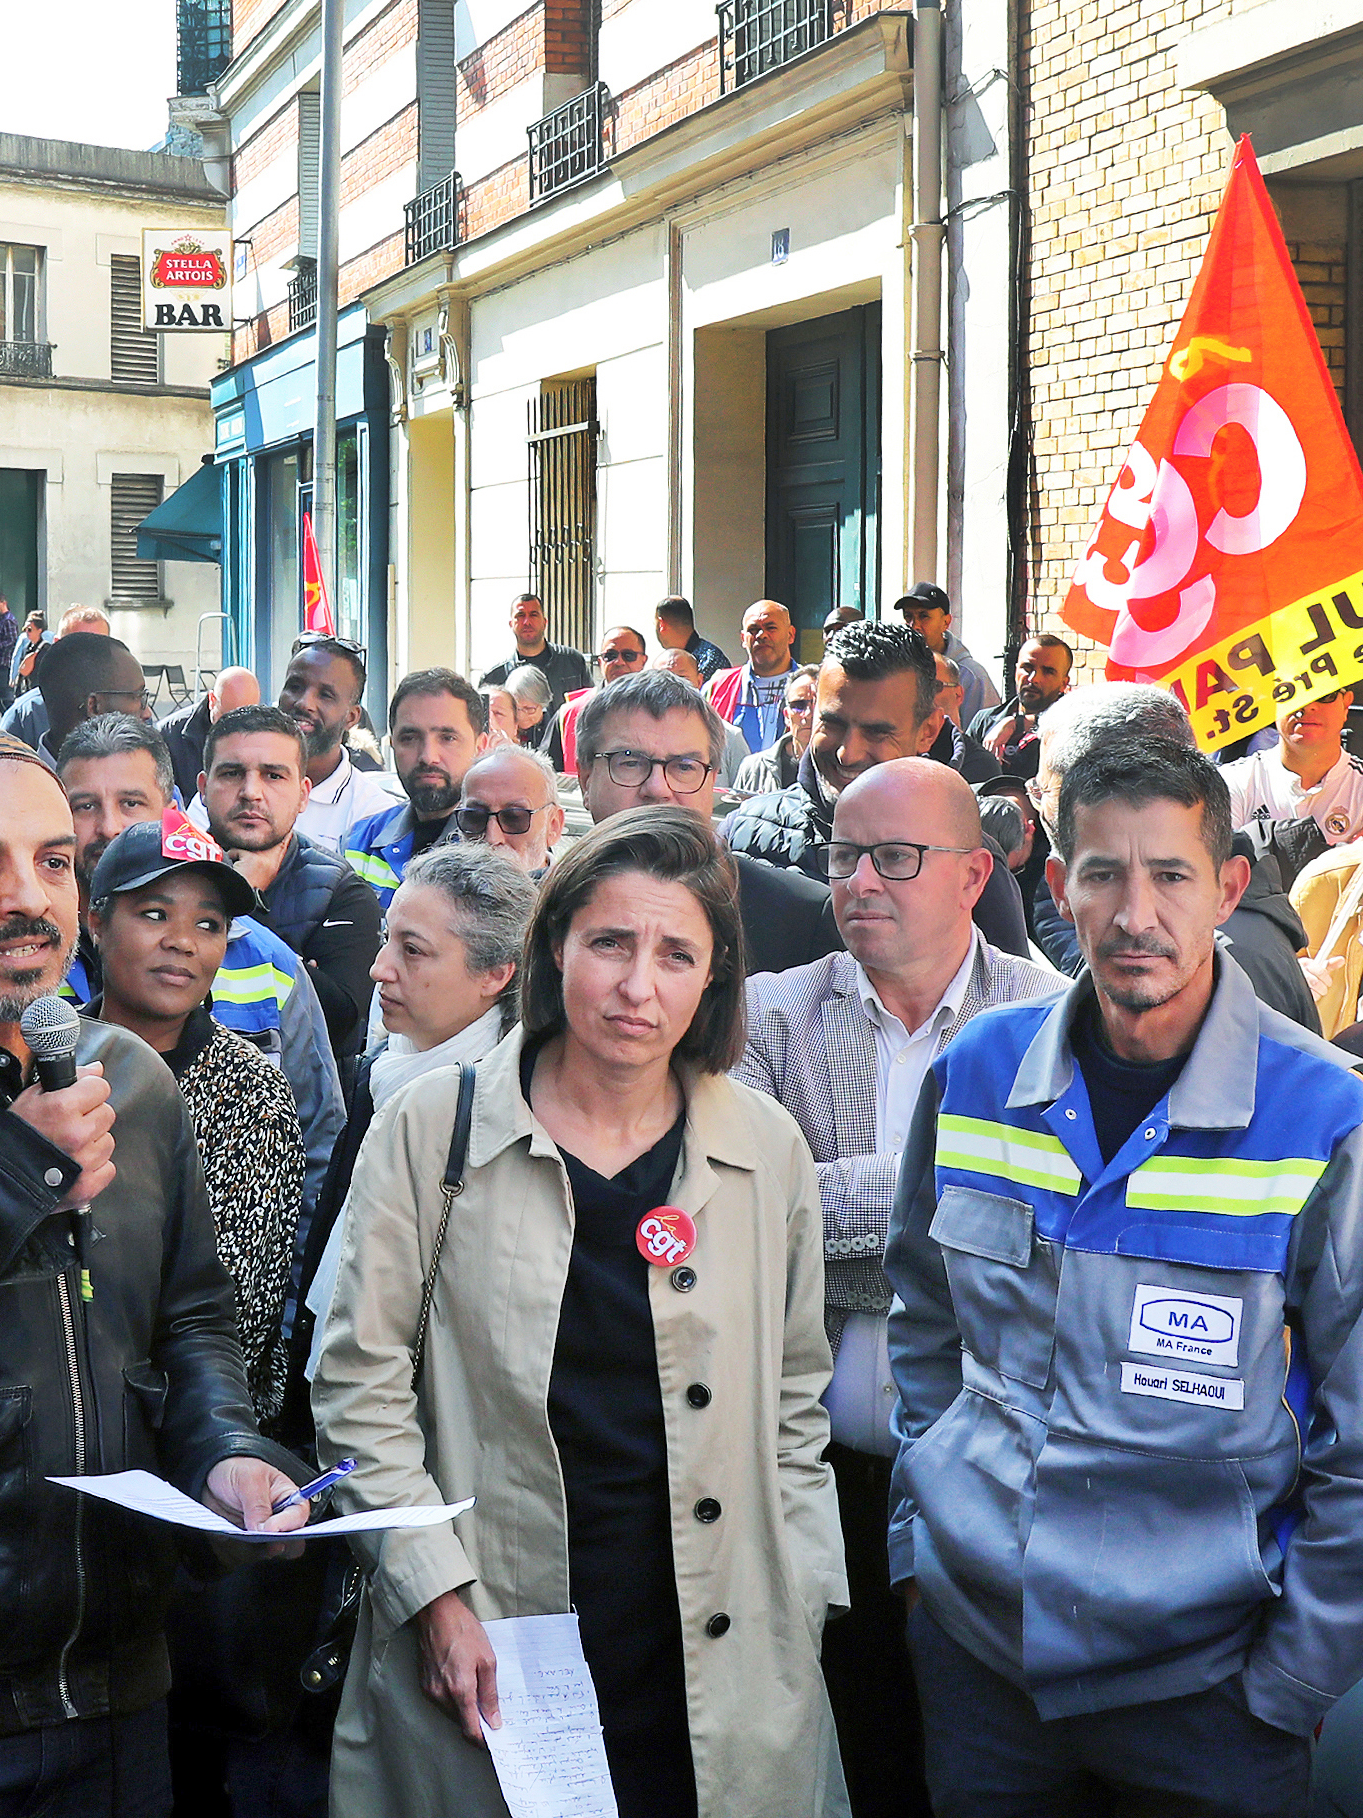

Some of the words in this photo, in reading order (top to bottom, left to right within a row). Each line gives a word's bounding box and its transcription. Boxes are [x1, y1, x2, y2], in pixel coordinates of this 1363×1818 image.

[166, 259, 213, 269] STELLA
[166, 271, 214, 281] ARTOIS
[154, 303, 224, 327] BAR
[640, 1218, 687, 1263] cgt
[1168, 1311, 1208, 1332] MA
[1156, 1338, 1173, 1349] MA
[1177, 1341, 1212, 1356] France
[1134, 1373, 1167, 1390] Houari
[1172, 1380, 1225, 1400] SELHAOUI
